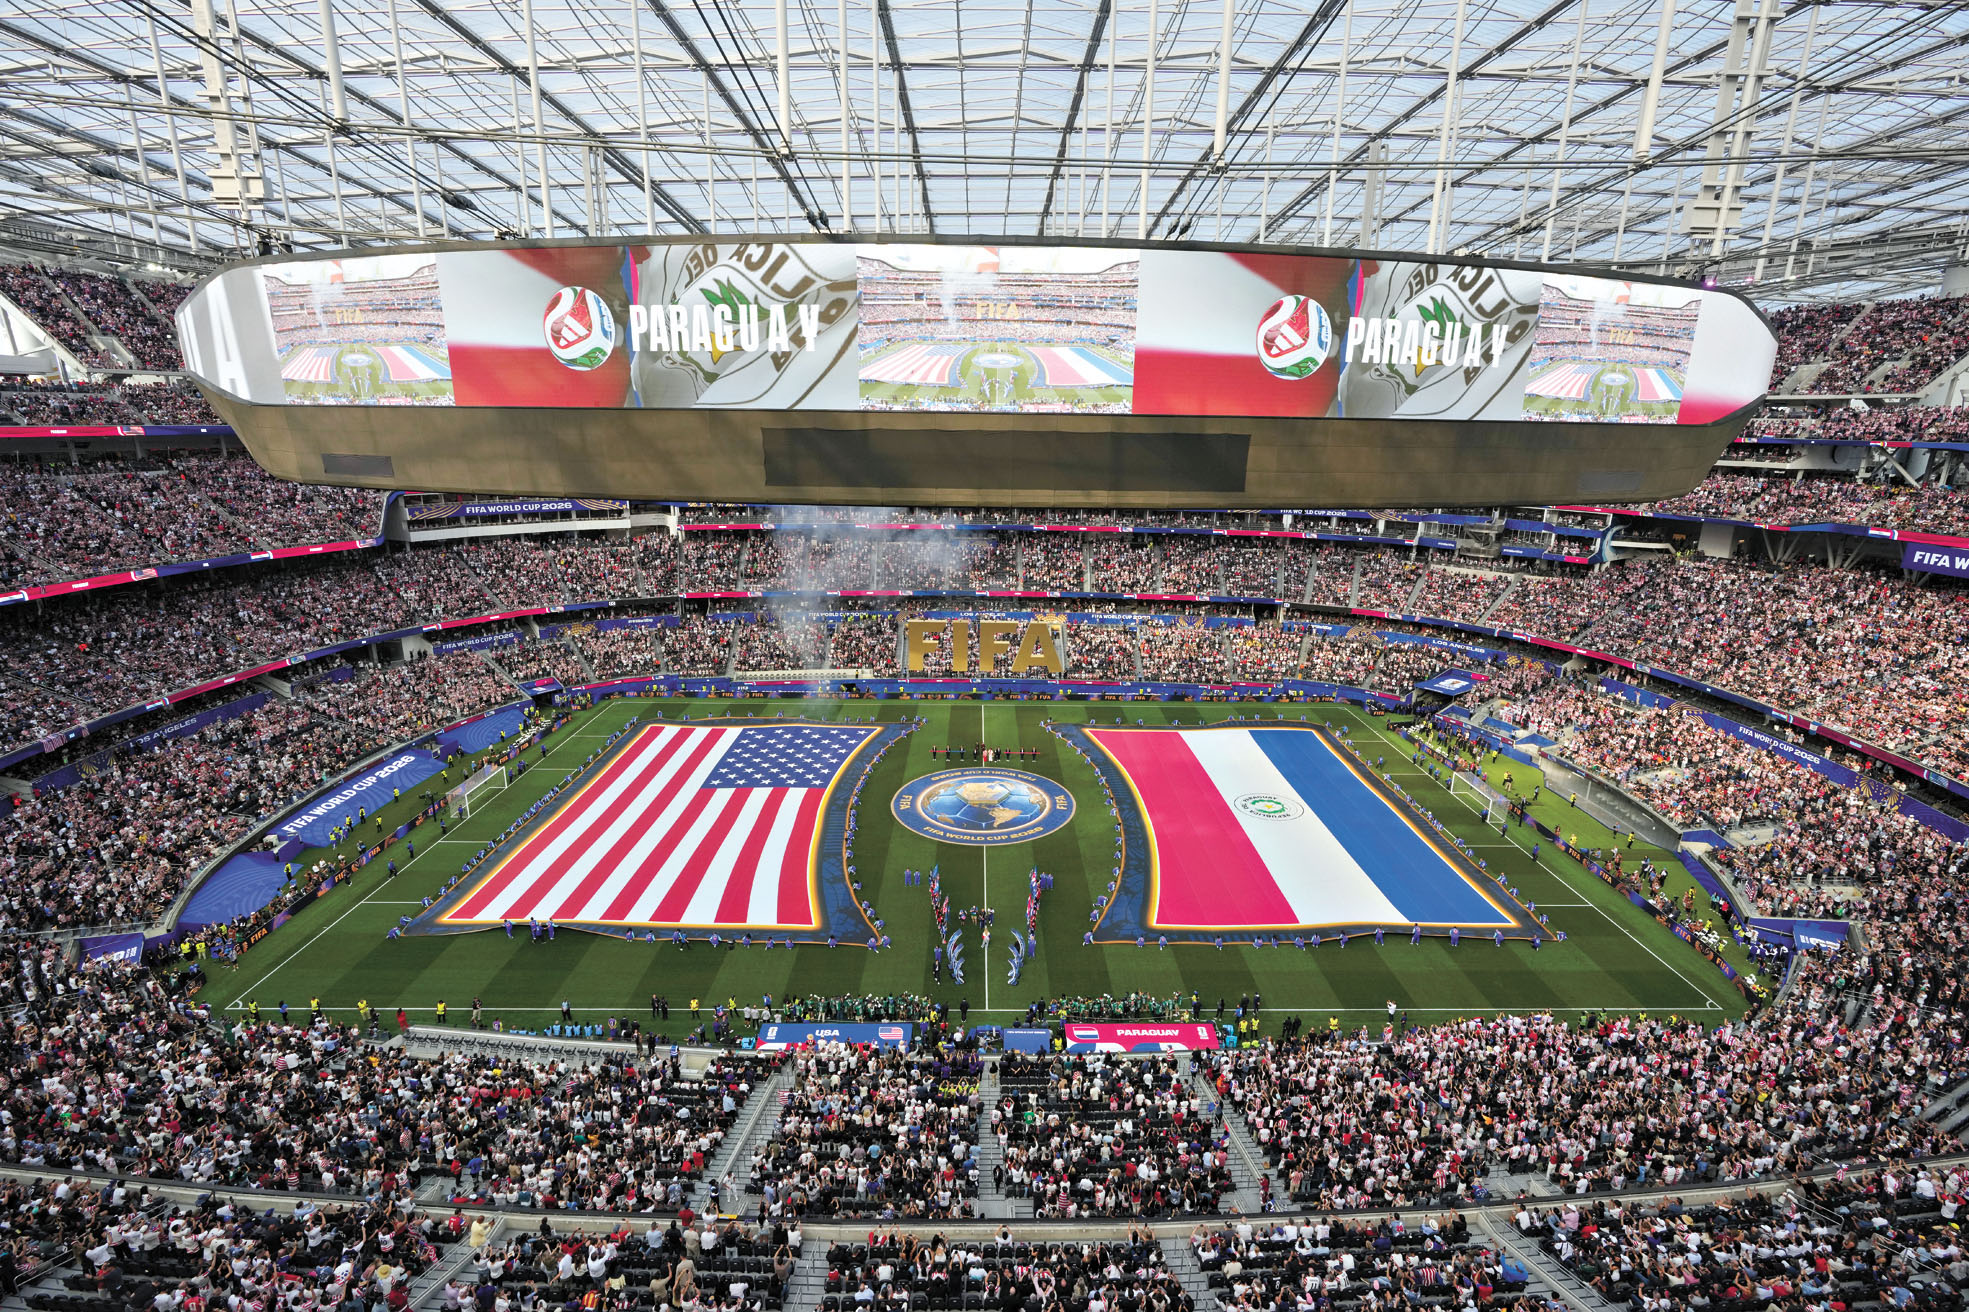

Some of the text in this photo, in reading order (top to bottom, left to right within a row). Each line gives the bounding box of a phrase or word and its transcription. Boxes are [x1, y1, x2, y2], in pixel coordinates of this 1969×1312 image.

[335, 309, 364, 323] FIFA
[976, 302, 1020, 319] FIFA
[629, 304, 820, 352] PARAGUAY
[1608, 329, 1635, 343] FIFA
[1345, 317, 1509, 368] PARAGUAY
[466, 506, 487, 514] FIFA
[488, 504, 521, 513] WORLD
[1913, 550, 1950, 568] FIFA
[907, 620, 1064, 672] FIFA
[1739, 726, 1753, 737] FIFA
[1779, 743, 1794, 752] CUP
[1794, 749, 1820, 764] 2026
[282, 755, 416, 832] FIFA WORLD CUP 2026
[428, 804, 439, 815] FIA
[900, 794, 912, 810] FIFA
[1056, 794, 1068, 810] FIFA
[923, 826, 944, 836] FIFA
[946, 833, 985, 841] WORLD
[1010, 826, 1044, 839] 2026
[368, 846, 381, 858] FIFA
[1568, 848, 1580, 860] FIFA
[334, 870, 344, 882] FIF
[1600, 870, 1612, 884] FIFA
[250, 928, 268, 944] FIFA
[1675, 926, 1691, 942] FIFA
[1716, 957, 1729, 974] FIFA
